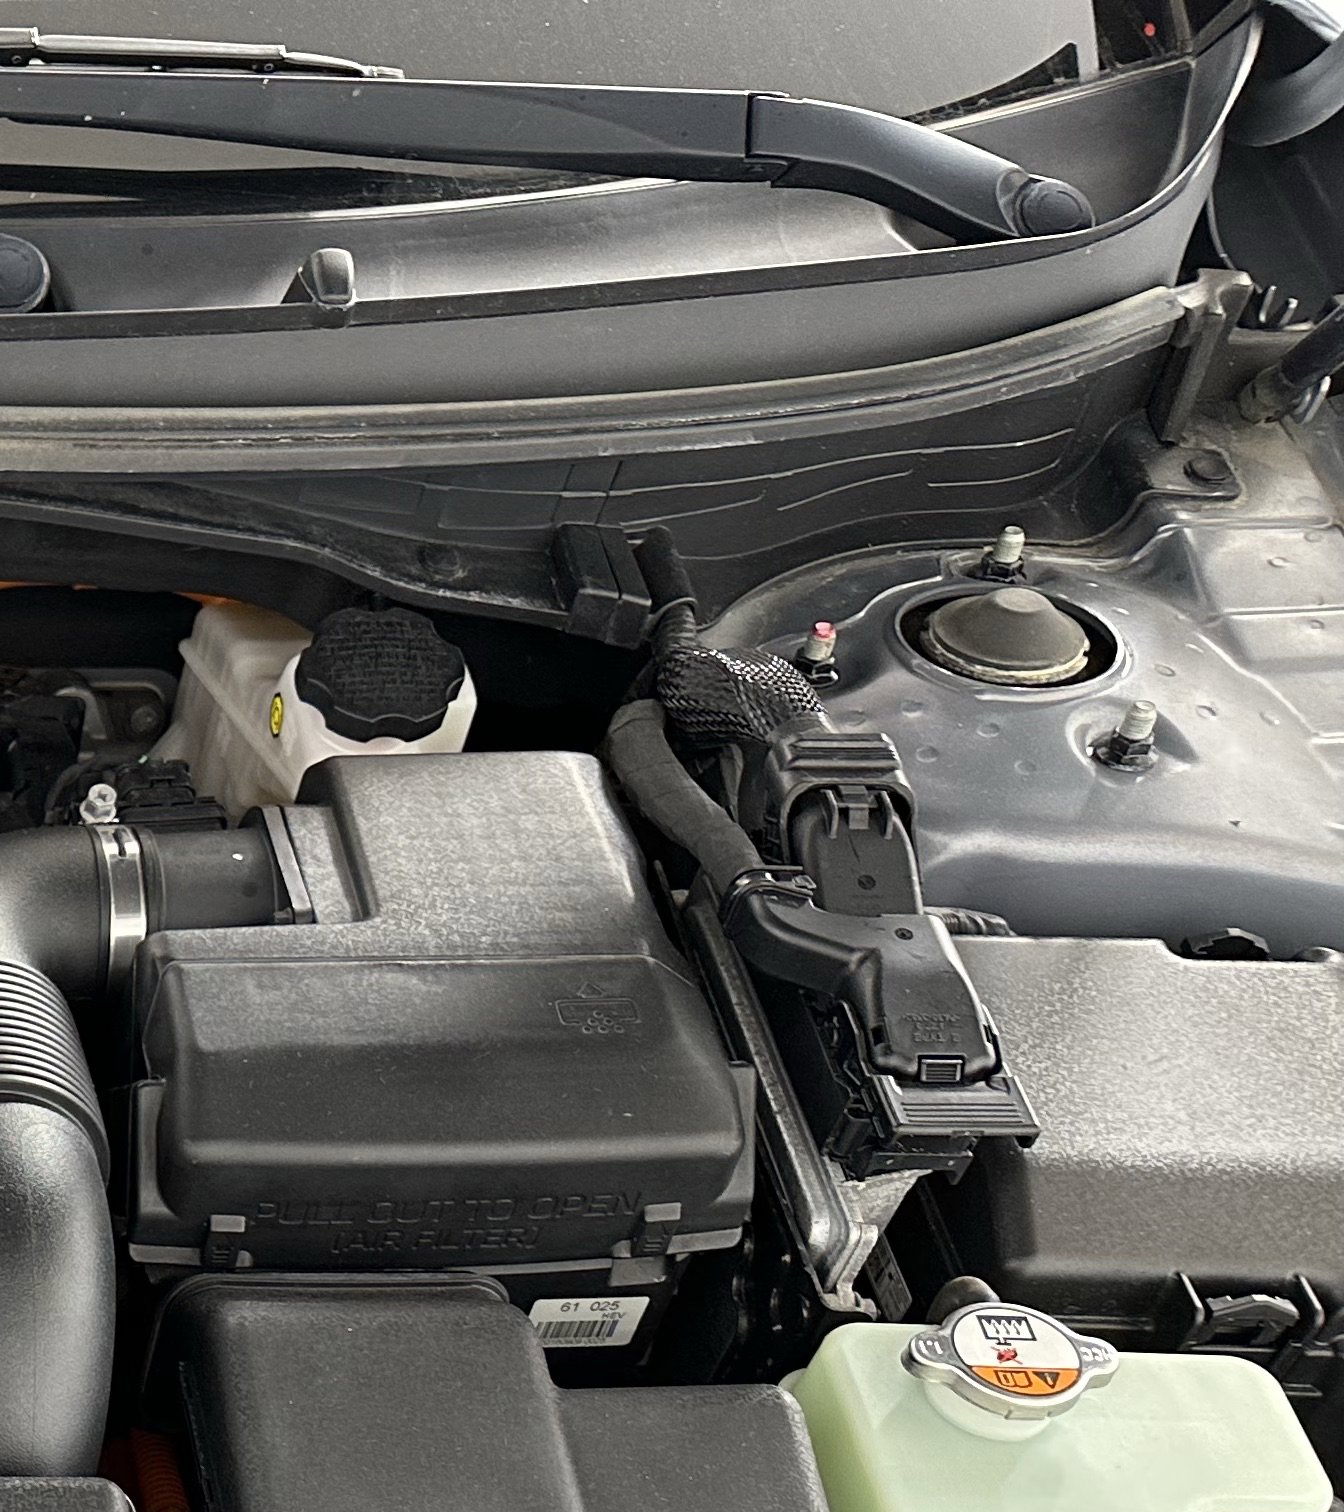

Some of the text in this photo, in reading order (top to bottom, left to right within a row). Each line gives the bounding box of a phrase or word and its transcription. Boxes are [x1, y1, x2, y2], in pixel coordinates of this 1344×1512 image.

[255, 1192, 644, 1226] PULL OUT TO OPEN
[560, 1300, 621, 1313] 61 025
